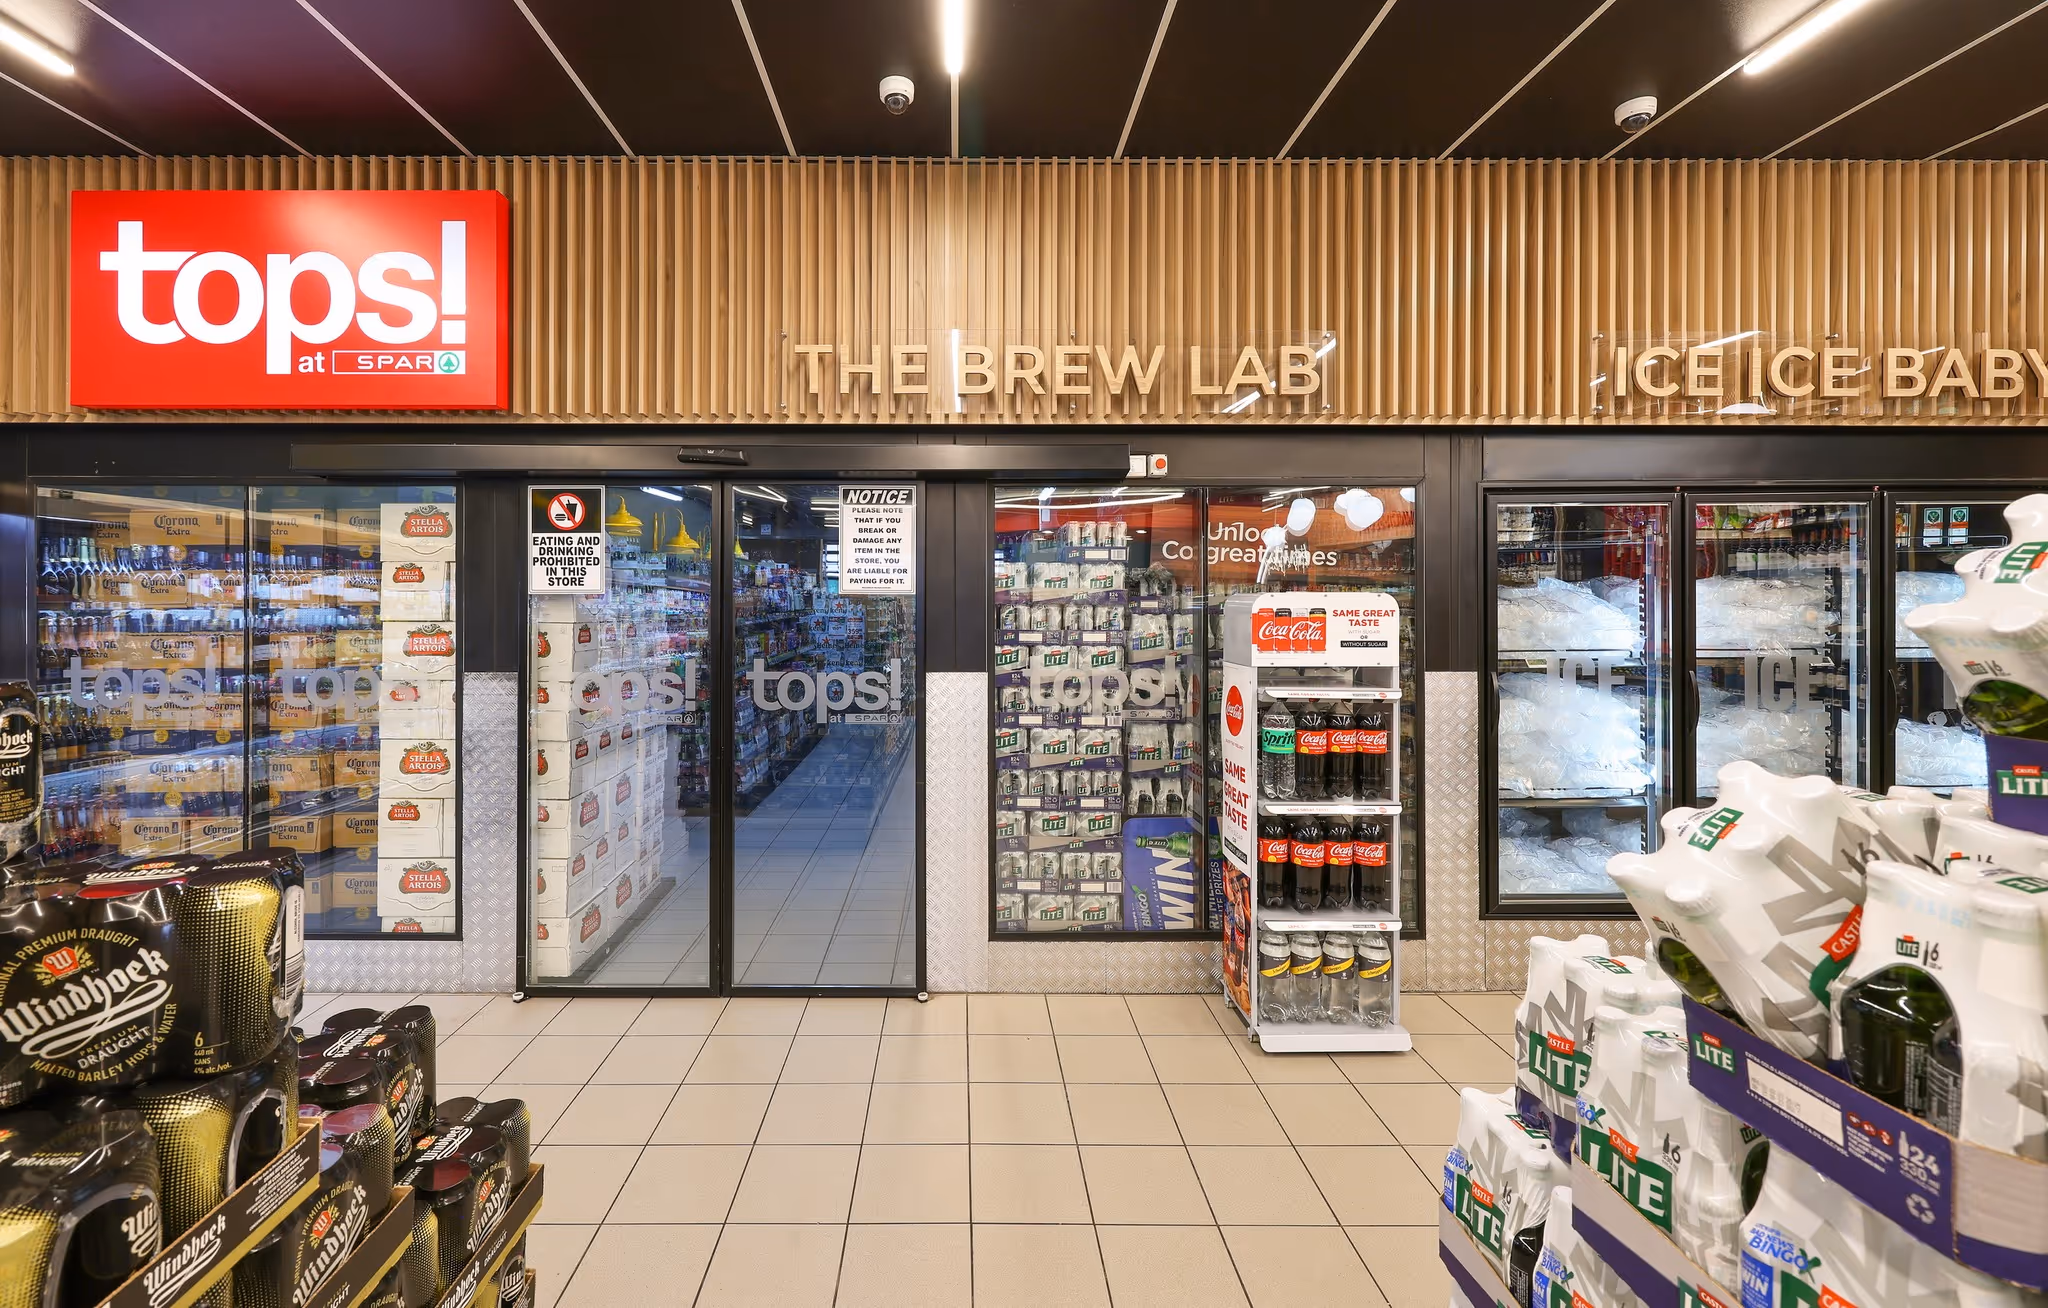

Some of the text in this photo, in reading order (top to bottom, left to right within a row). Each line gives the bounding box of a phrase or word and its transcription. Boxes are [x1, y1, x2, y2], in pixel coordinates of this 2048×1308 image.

[100, 221, 466, 374] tops!
[298, 352, 434, 373] at SPAR
[795, 344, 1321, 395] THE BREW LAB
[1615, 346, 1724, 398] ICE
[1748, 346, 1859, 398] ICE
[846, 490, 909, 504] NOTICE
[154, 514, 200, 529] Corona
[411, 518, 443, 526] STELLA
[165, 527, 191, 536] Extra
[410, 525, 444, 533] ARTOIS
[532, 536, 600, 546] EATING AND
[538, 546, 594, 556] DRINKING
[532, 556, 600, 566] PROHIBITED
[854, 557, 900, 566] STORE, YOU
[2001, 544, 2043, 580] LITE
[545, 566, 587, 576] IN THIS
[547, 577, 585, 586] STORE
[849, 577, 905, 585] PAYING FOR IT.
[1045, 579, 1067, 588] LITE
[1090, 579, 1112, 588] LITE
[1332, 609, 1396, 617] SAME GREAT
[1348, 619, 1380, 627] TASTE
[1258, 620, 1325, 641] Coca-Cola
[412, 637, 446, 645] STELLA
[1140, 635, 1164, 648] LITE
[411, 644, 447, 652] ARTOIS
[996, 653, 1018, 664] LITE
[1045, 653, 1067, 664] LITE
[1092, 654, 1115, 664] LITE
[1547, 654, 1626, 700] ICE
[1745, 654, 1825, 710] ICE
[745, 658, 902, 724] tops!
[829, 713, 888, 723] at SPAR
[996, 735, 1016, 746] LITE
[1044, 744, 1066, 754] LITE
[1086, 743, 1110, 754] LITE
[1139, 750, 1161, 760] LITE
[409, 755, 442, 763] STELLA
[150, 761, 195, 774] Corona
[355, 767, 376, 776] Extra
[408, 762, 443, 770] ARTOIS
[1165, 764, 1180, 773] LITE
[1224, 758, 1246, 783] SAME
[162, 774, 187, 783] Extra
[1224, 781, 1249, 809] GREAT
[1224, 801, 1248, 831] TASTE
[133, 823, 170, 836] Corona
[202, 823, 239, 836] Corona
[354, 826, 375, 835] Extra
[1043, 818, 1066, 830] LITE
[1089, 818, 1112, 831] LITE
[1694, 808, 1741, 850] LITE
[143, 833, 163, 842] Extra
[278, 832, 298, 841] Extra
[1070, 840, 1084, 848] LITE
[408, 873, 442, 882] STELLA
[1210, 861, 1223, 895] PRIZES
[354, 887, 374, 895] Extra
[408, 881, 443, 889] ARTOIS
[1151, 846, 1194, 930] WIN
[1041, 909, 1062, 920] LITE
[1085, 910, 1105, 921] LITE
[1137, 893, 1152, 927] BINGO
[18, 926, 139, 961] PREMIUM DRAUGHT
[1897, 940, 1919, 956] LITE
[0, 946, 170, 1043] Windhoek
[30, 1002, 177, 1082] MALTED BARLEY HOPS WATER
[79, 1024, 138, 1056] PREMIUM
[194, 1031, 204, 1047] 6
[76, 1027, 150, 1070] DRAUGHT
[1695, 1038, 1733, 1072] LITE
[194, 1057, 211, 1065] CANS
[1533, 1044, 1592, 1092] LITE
[1670, 1144, 1682, 1165] 6
[1909, 1146, 1940, 1176] 24
[12, 1156, 79, 1167] DRAUGHT
[1899, 1158, 1927, 1181] 330
[1589, 1142, 1665, 1217] LITE
[1472, 1184, 1492, 1204] CASTLE
[303, 1190, 330, 1237] PREMIUM
[466, 1165, 512, 1252] Windhoek
[1461, 1188, 1502, 1250] LITE
[292, 1183, 367, 1305] Windhoek
[1750, 1227, 1796, 1253] BAD NEWS
[143, 1213, 227, 1297] Windhoek
[483, 1232, 508, 1267] DRAUGHT
[1748, 1235, 1809, 1271] BINGO
[1541, 1257, 1568, 1280] BINGO
